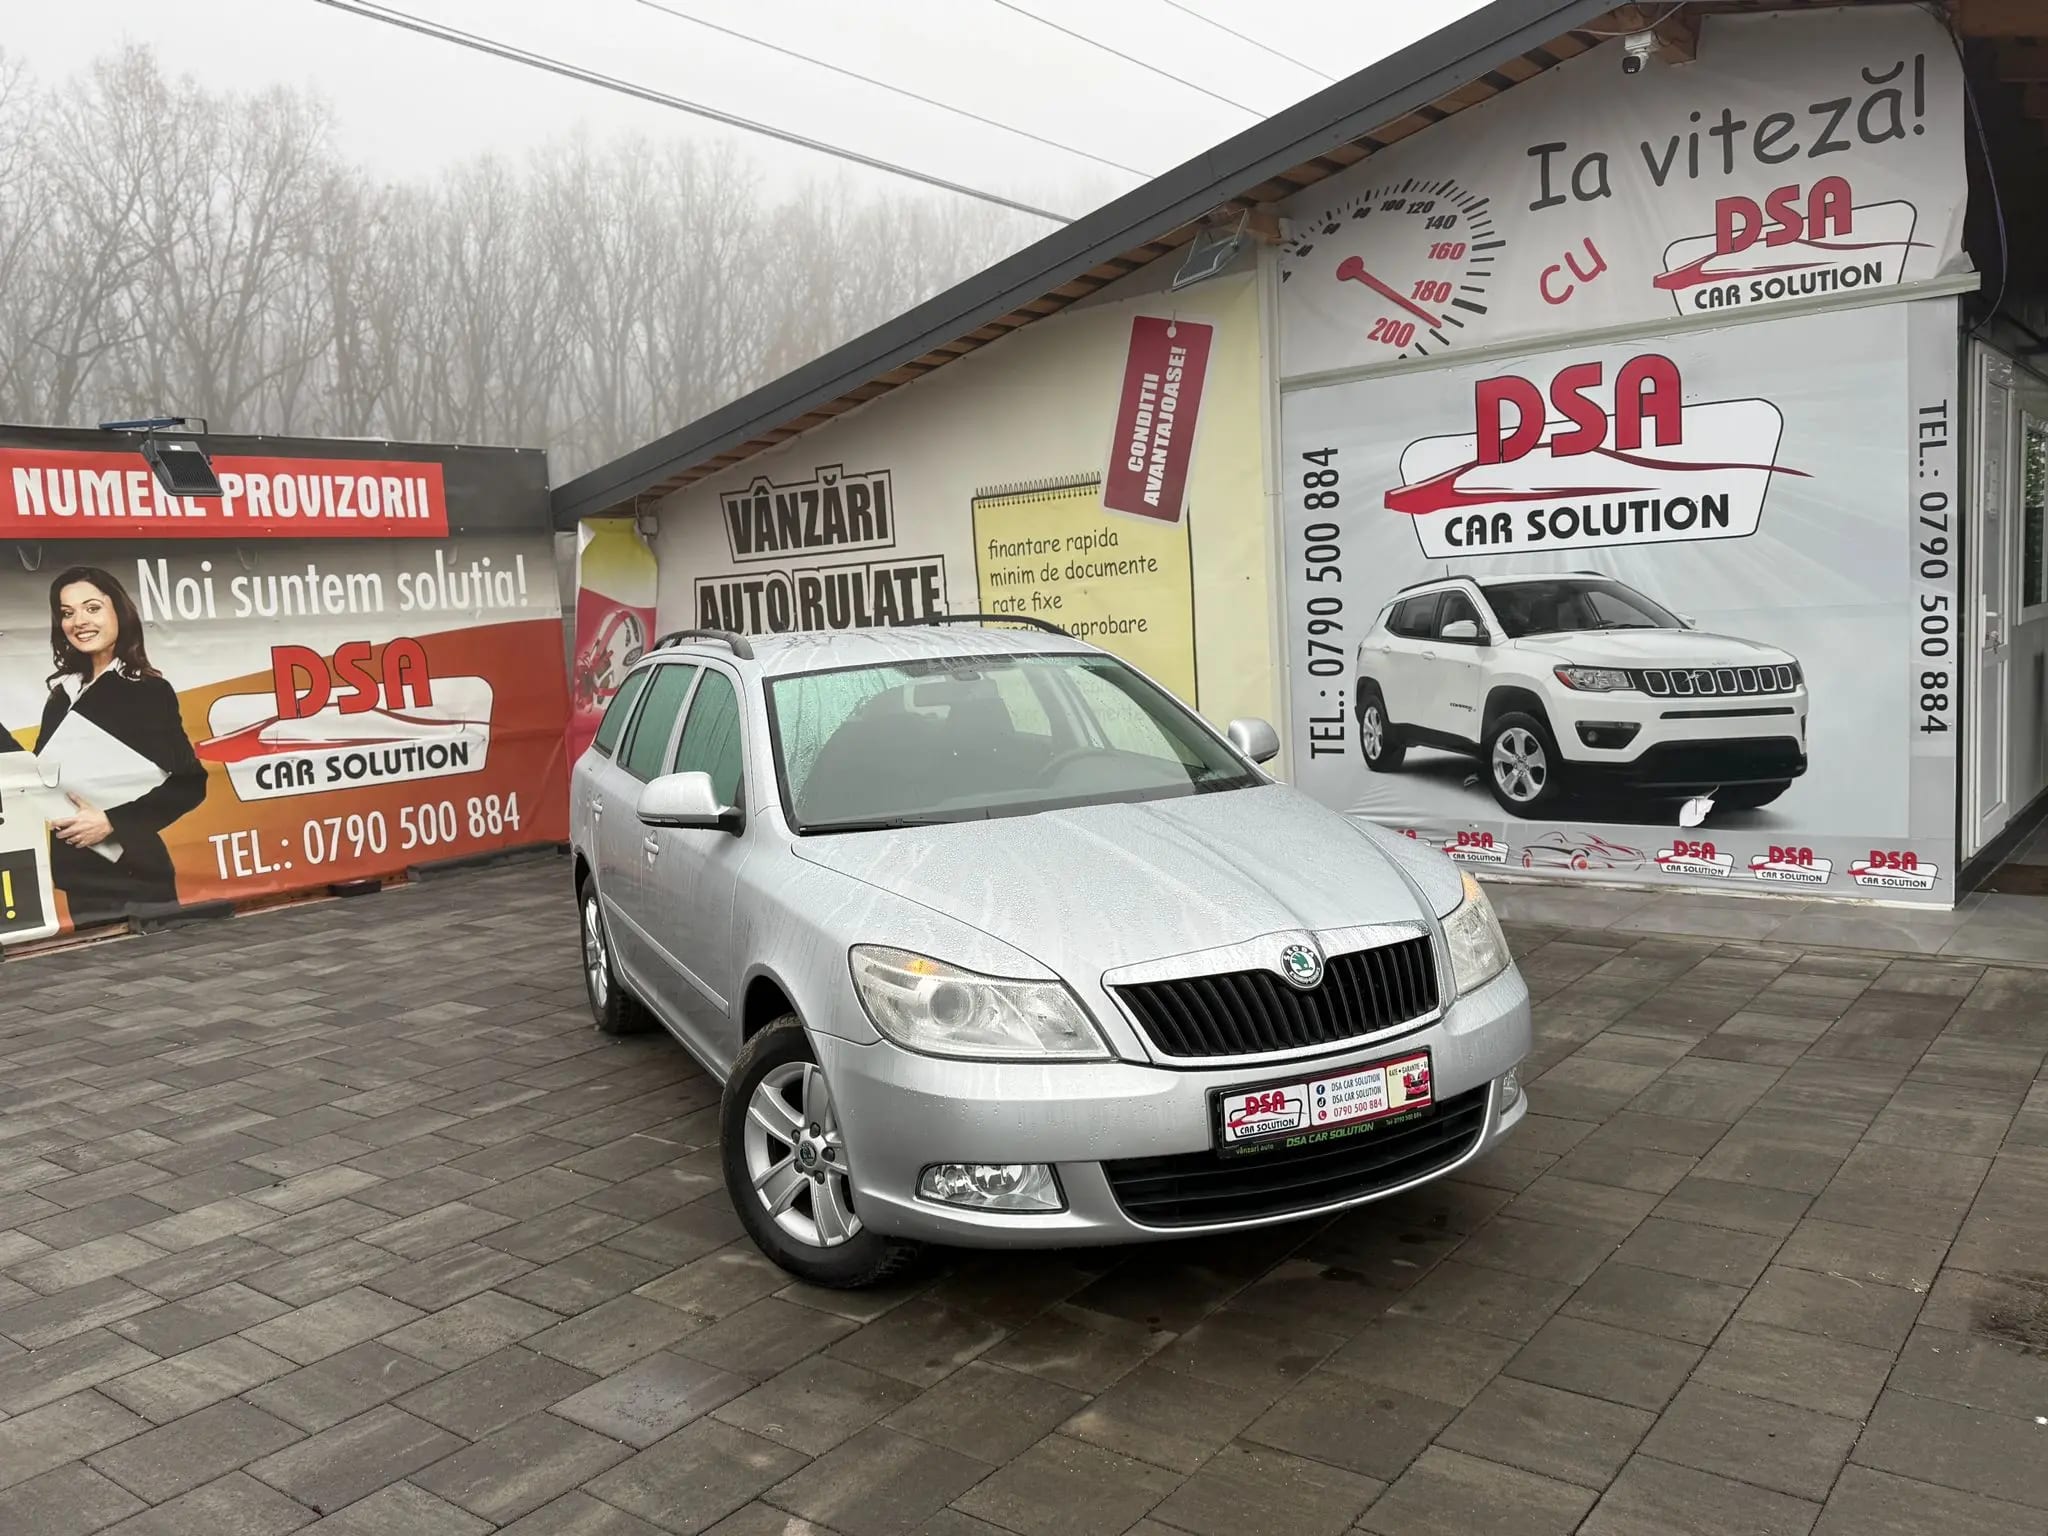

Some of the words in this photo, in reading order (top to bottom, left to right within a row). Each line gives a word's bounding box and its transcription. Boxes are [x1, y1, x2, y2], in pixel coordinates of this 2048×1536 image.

[1527, 141, 1612, 212] Ia
[1640, 53, 1926, 187] viteză!
[1406, 200, 1435, 215] 120
[1424, 214, 1457, 231] 140
[1714, 175, 1853, 255] DSA
[1427, 242, 1466, 262] 160
[1539, 236, 1608, 305] cu
[1694, 283, 1741, 310] CAR
[1750, 261, 1882, 304] SOLUTION
[1411, 279, 1452, 304] 180
[1367, 317, 1416, 348] 200
[1127, 373, 1160, 473] CONDITII
[1474, 353, 1683, 465] DSA
[1143, 346, 1187, 507] AVANTAJOASE!
[1302, 447, 1339, 510] 884
[219, 472, 430, 518] PROVIZORII
[727, 474, 888, 554] VÂNZĂRI
[1444, 513, 1513, 547] CAR
[1527, 493, 1730, 542] SOLUTION
[988, 537, 1061, 560] finantare
[1066, 527, 1119, 555] rapida
[1918, 492, 1949, 579] 0790
[1303, 523, 1342, 583] 500
[990, 566, 1035, 587] minim
[1040, 562, 1060, 583] de
[1065, 555, 1159, 580] documente
[137, 558, 217, 621] Noi
[230, 564, 385, 619] suntem
[700, 579, 791, 635] AUTO
[798, 564, 943, 632] RULATE
[992, 595, 1026, 613] rate
[1031, 591, 1063, 612] fixe
[1071, 614, 1149, 640] aprobare
[1306, 597, 1345, 677] 0790
[1920, 594, 1949, 658] 500
[271, 637, 433, 720] DSA
[1919, 671, 1949, 735] 884
[255, 757, 315, 790] CAR
[326, 741, 469, 783] SOLUTION
[303, 810, 388, 864] 0790
[400, 800, 457, 849] 500
[466, 791, 521, 838] 884
[1457, 831, 1493, 848] DSA
[1466, 853, 1502, 863] SOLUTION
[1673, 840, 1716, 860] DSA
[1769, 845, 1813, 866] DSA
[1869, 850, 1918, 870] DSA
[1666, 864, 1682, 873] CAR
[1683, 865, 1724, 876] SOLUTION
[1761, 871, 1777, 880] CAR
[1779, 871, 1822, 882] SOLUTION
[1862, 876, 1879, 885] CAR
[1880, 877, 1927, 888] SOLUTION
[1331, 1082, 1342, 1092] DSA
[1343, 1079, 1354, 1090] CAR
[1332, 1094, 1343, 1104] DSA
[1344, 1091, 1355, 1101] CAR
[1245, 1090, 1285, 1116] DSA
[1333, 1105, 1352, 1117] 0790
[1354, 1102, 1368, 1113] 500
[1369, 1098, 1382, 1110] 884
[1240, 1124, 1254, 1135] CAR
[1256, 1118, 1295, 1133] SOLUTION
[1286, 1135, 1307, 1148] DSA
[1308, 1131, 1328, 1144] CAR
[1329, 1122, 1374, 1140] SOLUTION
